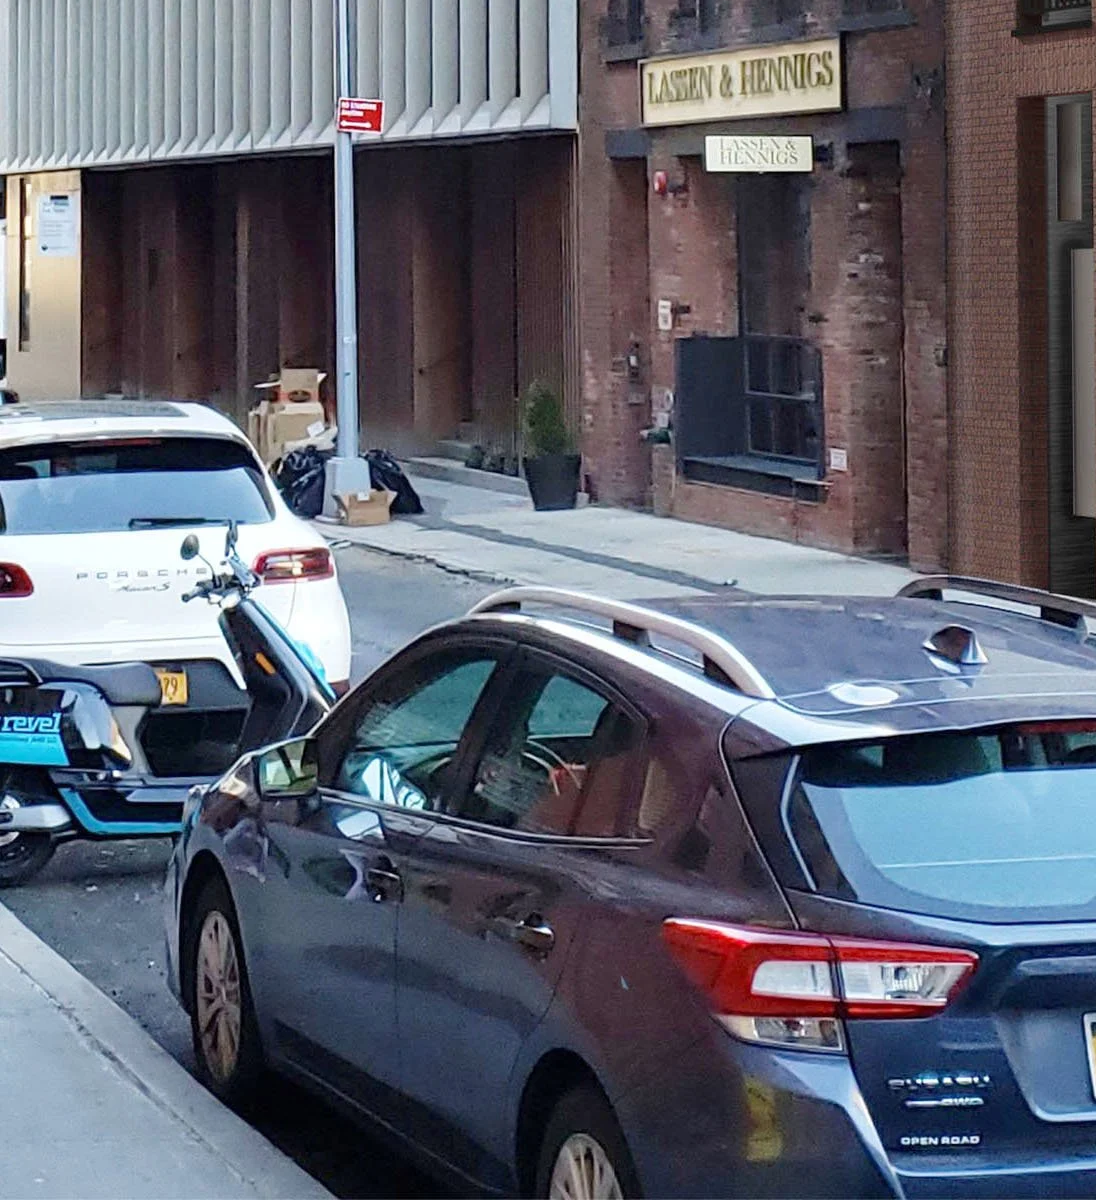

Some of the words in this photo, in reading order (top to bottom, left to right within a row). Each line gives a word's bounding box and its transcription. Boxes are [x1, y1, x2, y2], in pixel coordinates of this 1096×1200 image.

[719, 63, 733, 99] &
[739, 50, 834, 96] HENNIGS
[719, 138, 781, 151] LASSEN
[785, 139, 797, 151] &
[719, 150, 799, 165] HENNIGS
[76, 567, 208, 580] PORSCHE
[1, 712, 62, 733] revel
[900, 1137, 939, 1146] OPEN
[941, 1136, 980, 1145] ROAD
